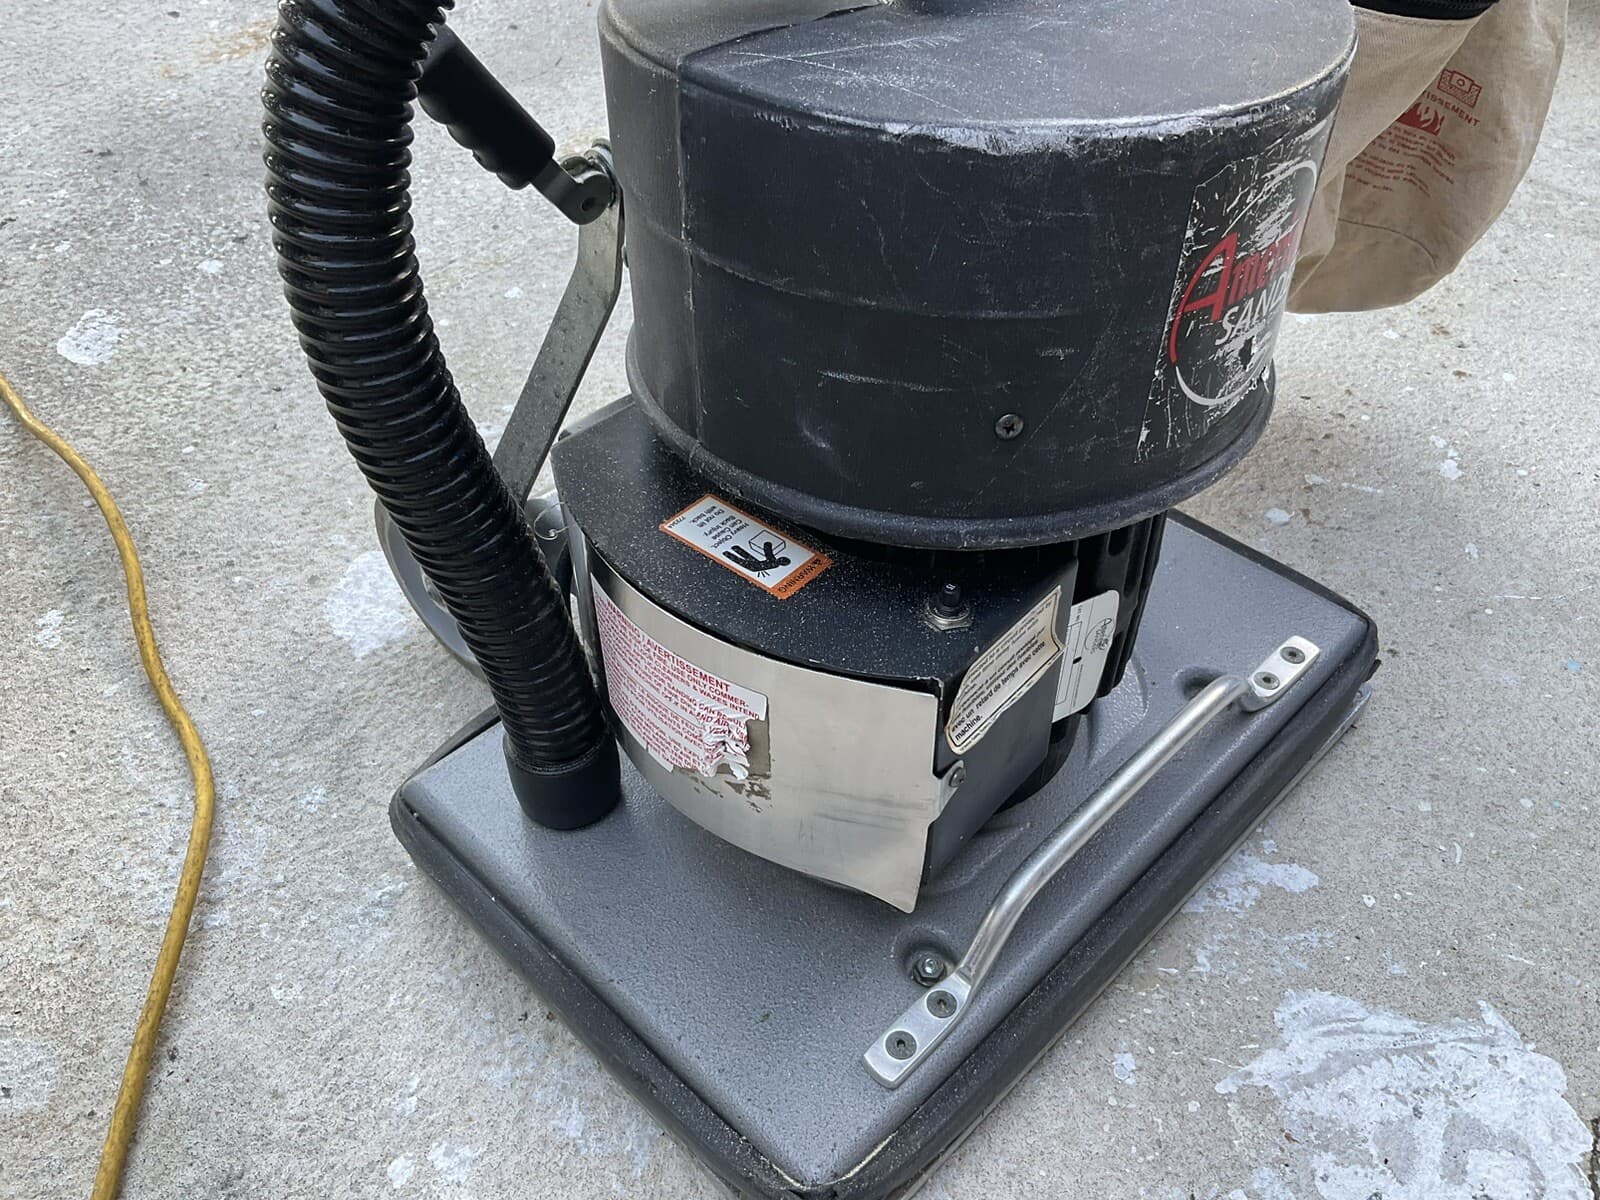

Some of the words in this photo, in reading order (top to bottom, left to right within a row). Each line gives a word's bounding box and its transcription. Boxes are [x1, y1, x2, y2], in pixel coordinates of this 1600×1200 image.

[1423, 90, 1480, 127] ISSEMENT
[1215, 270, 1290, 346] SAND
[646, 638, 730, 692] AVERTISSEMENT
[976, 689, 994, 710] retard
[993, 683, 1001, 692] de
[1001, 666, 1019, 685] temps
[1019, 654, 1032, 669] avec
[1032, 641, 1045, 656] cette
[687, 675, 707, 689] ONLY
[709, 686, 750, 708] COMMER-
[700, 689, 728, 706] WAXES
[955, 715, 983, 741] machine.
